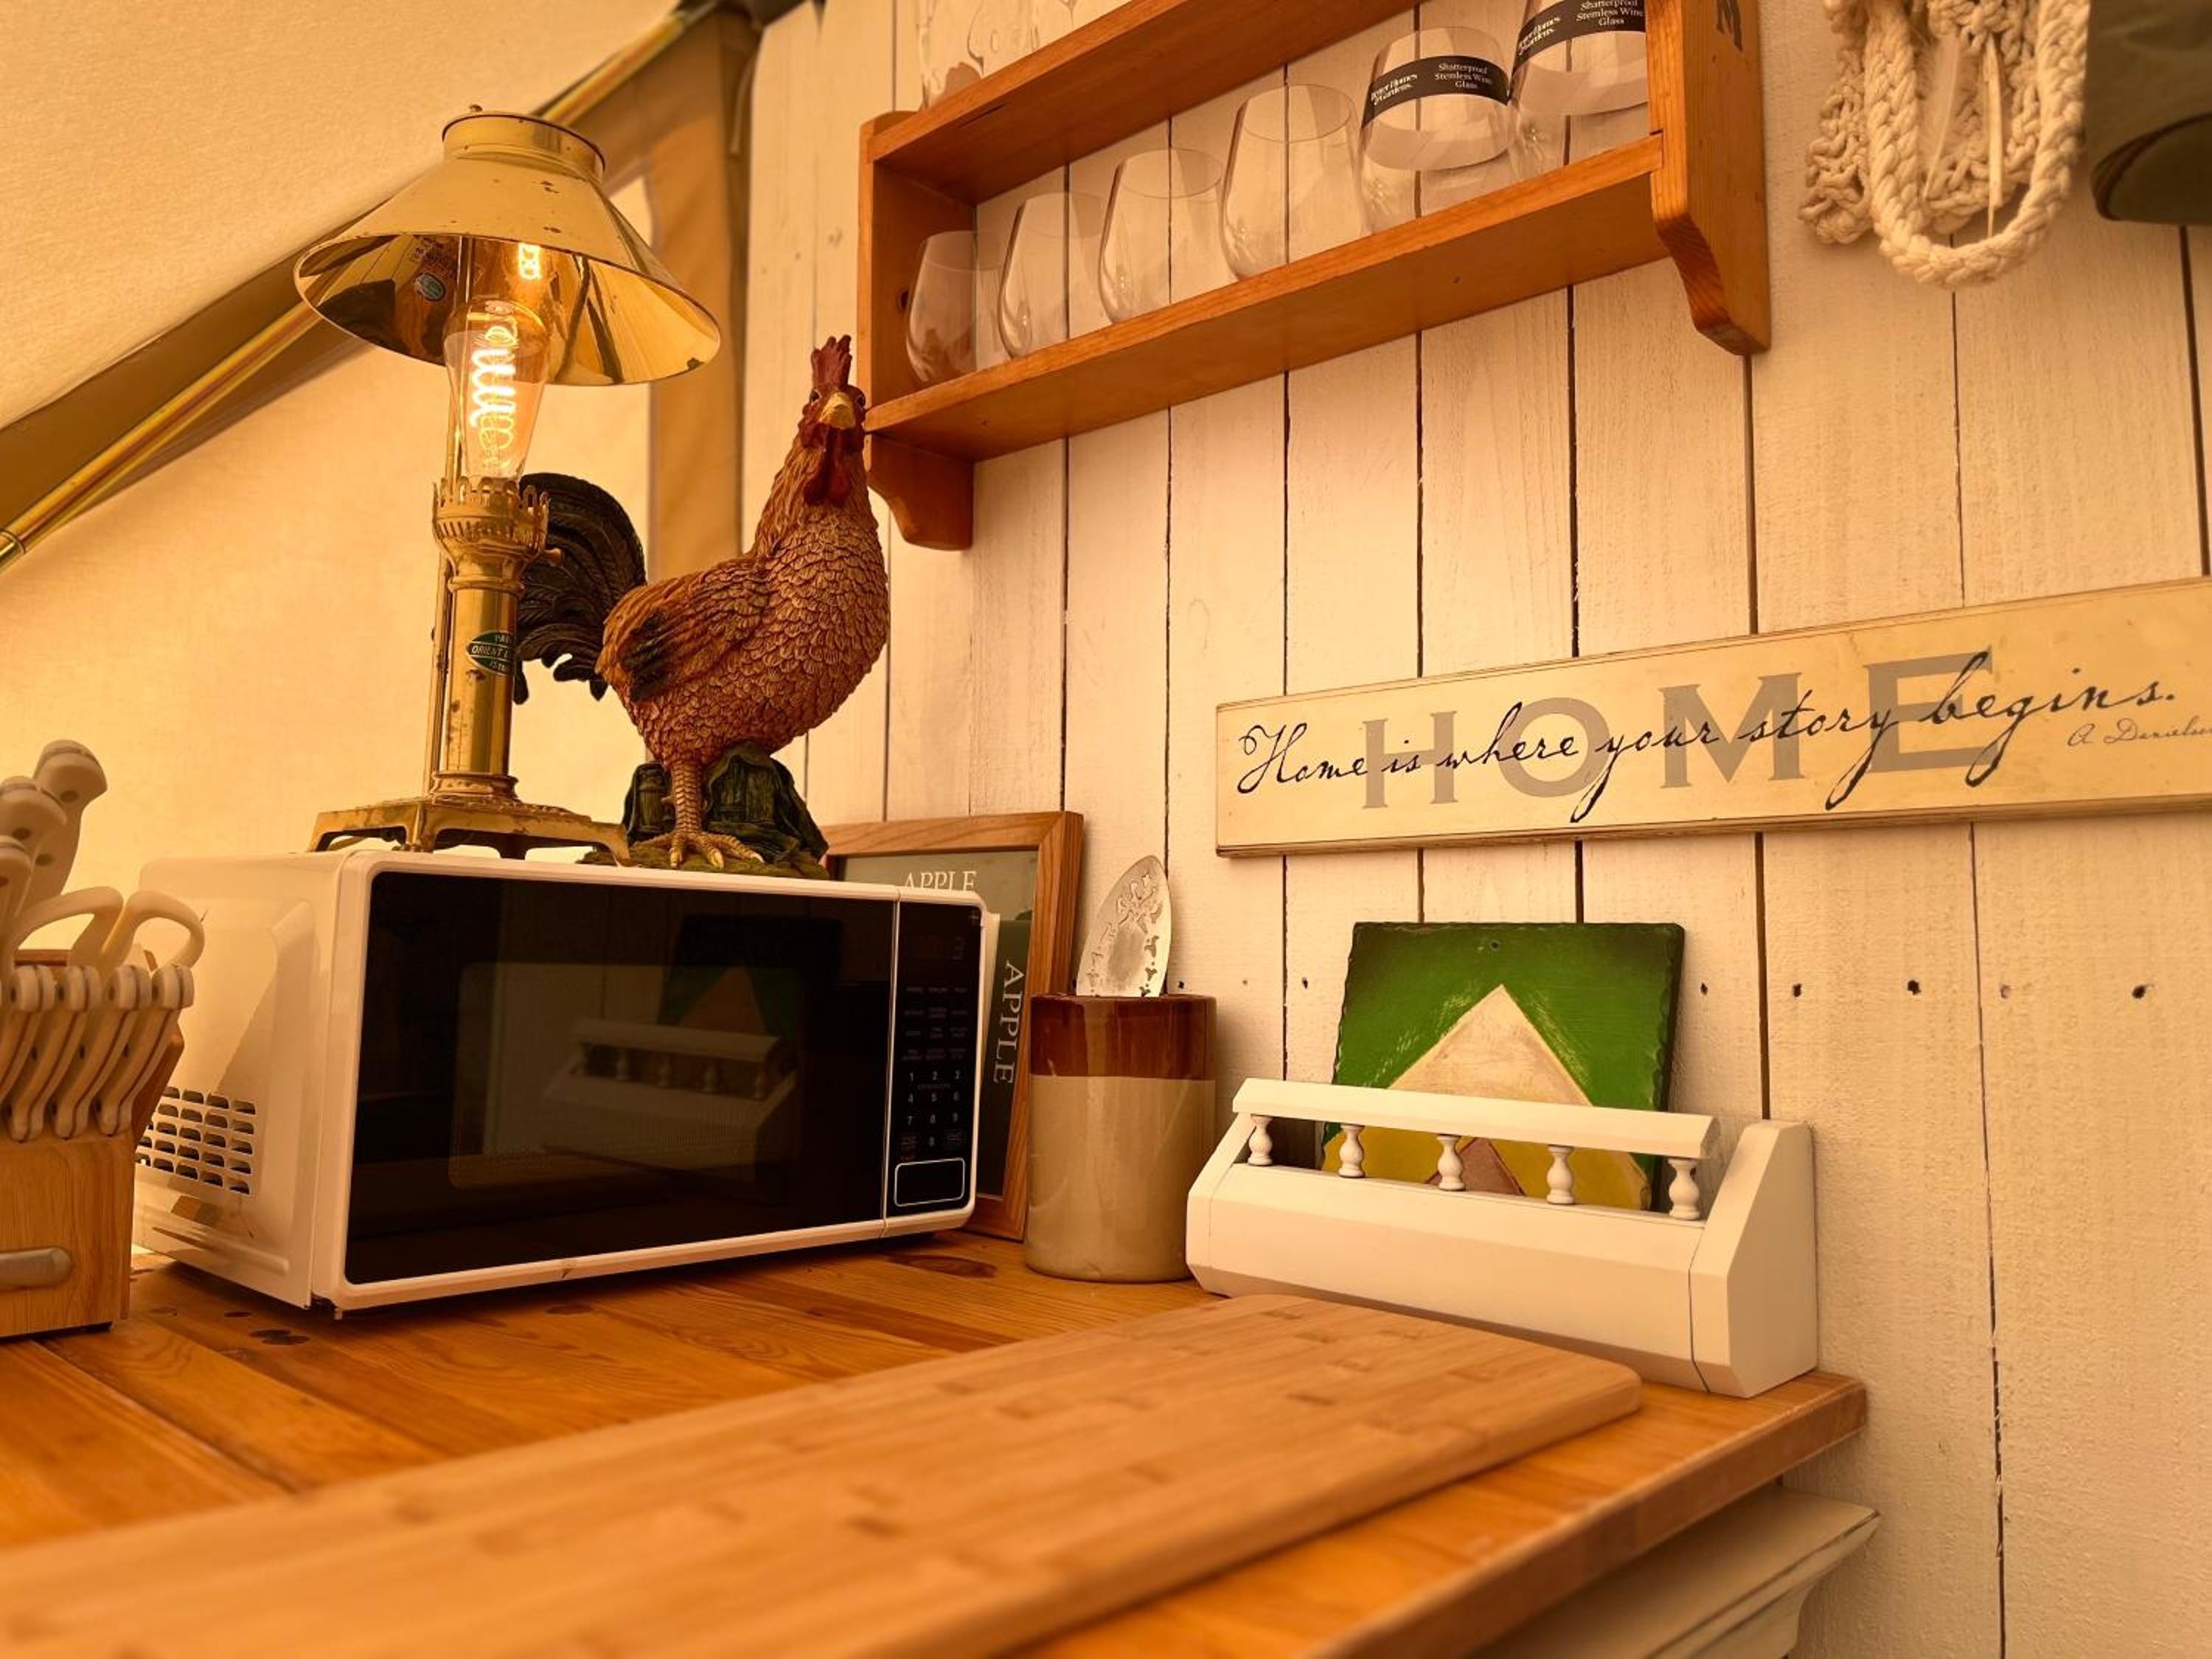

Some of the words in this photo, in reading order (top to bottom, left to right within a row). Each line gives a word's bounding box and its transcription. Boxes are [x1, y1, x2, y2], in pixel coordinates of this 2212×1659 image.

[1576, 8, 1618, 21] Stemless
[1599, 17, 1624, 26] Glass
[1439, 63, 1487, 74] Shatterproof
[1435, 72, 1472, 80] Stemless
[1455, 80, 1478, 89] Glass
[1363, 645, 1993, 810] HOME
[1237, 722, 1368, 794] Home
[1381, 739, 1422, 773] is
[1434, 701, 1579, 770] where
[1570, 720, 1720, 823] your
[1737, 689, 1899, 811] story
[1917, 650, 2175, 787] begins.
[905, 869, 978, 891] APPLE
[992, 959, 1026, 1085] APPLE
[931, 1070, 939, 1082] 2
